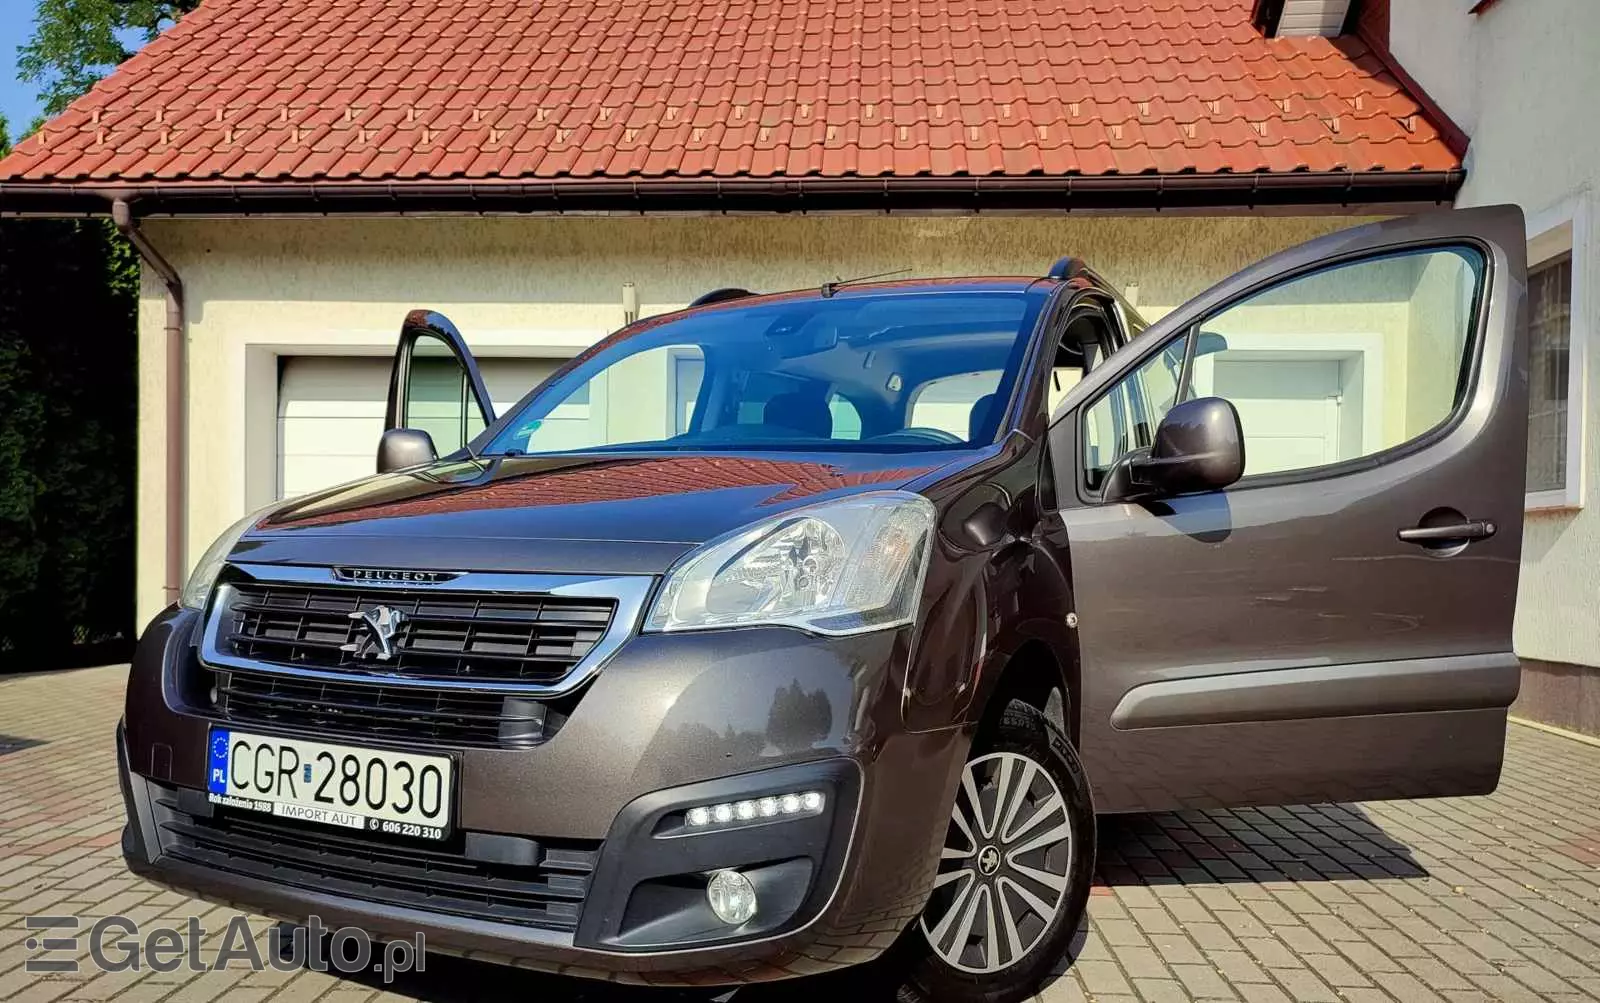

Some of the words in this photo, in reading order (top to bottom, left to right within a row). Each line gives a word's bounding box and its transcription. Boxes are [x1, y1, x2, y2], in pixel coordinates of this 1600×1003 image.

[353, 570, 438, 580] PEUGEOT
[212, 768, 226, 783] PL
[230, 740, 298, 799] CGR
[313, 751, 443, 819] 28030
[208, 792, 222, 804] Rok
[281, 805, 328, 822] IMPORT
[331, 813, 358, 825] AUT
[382, 821, 401, 833] 606
[402, 824, 421, 836] 220
[422, 828, 442, 840] 310
